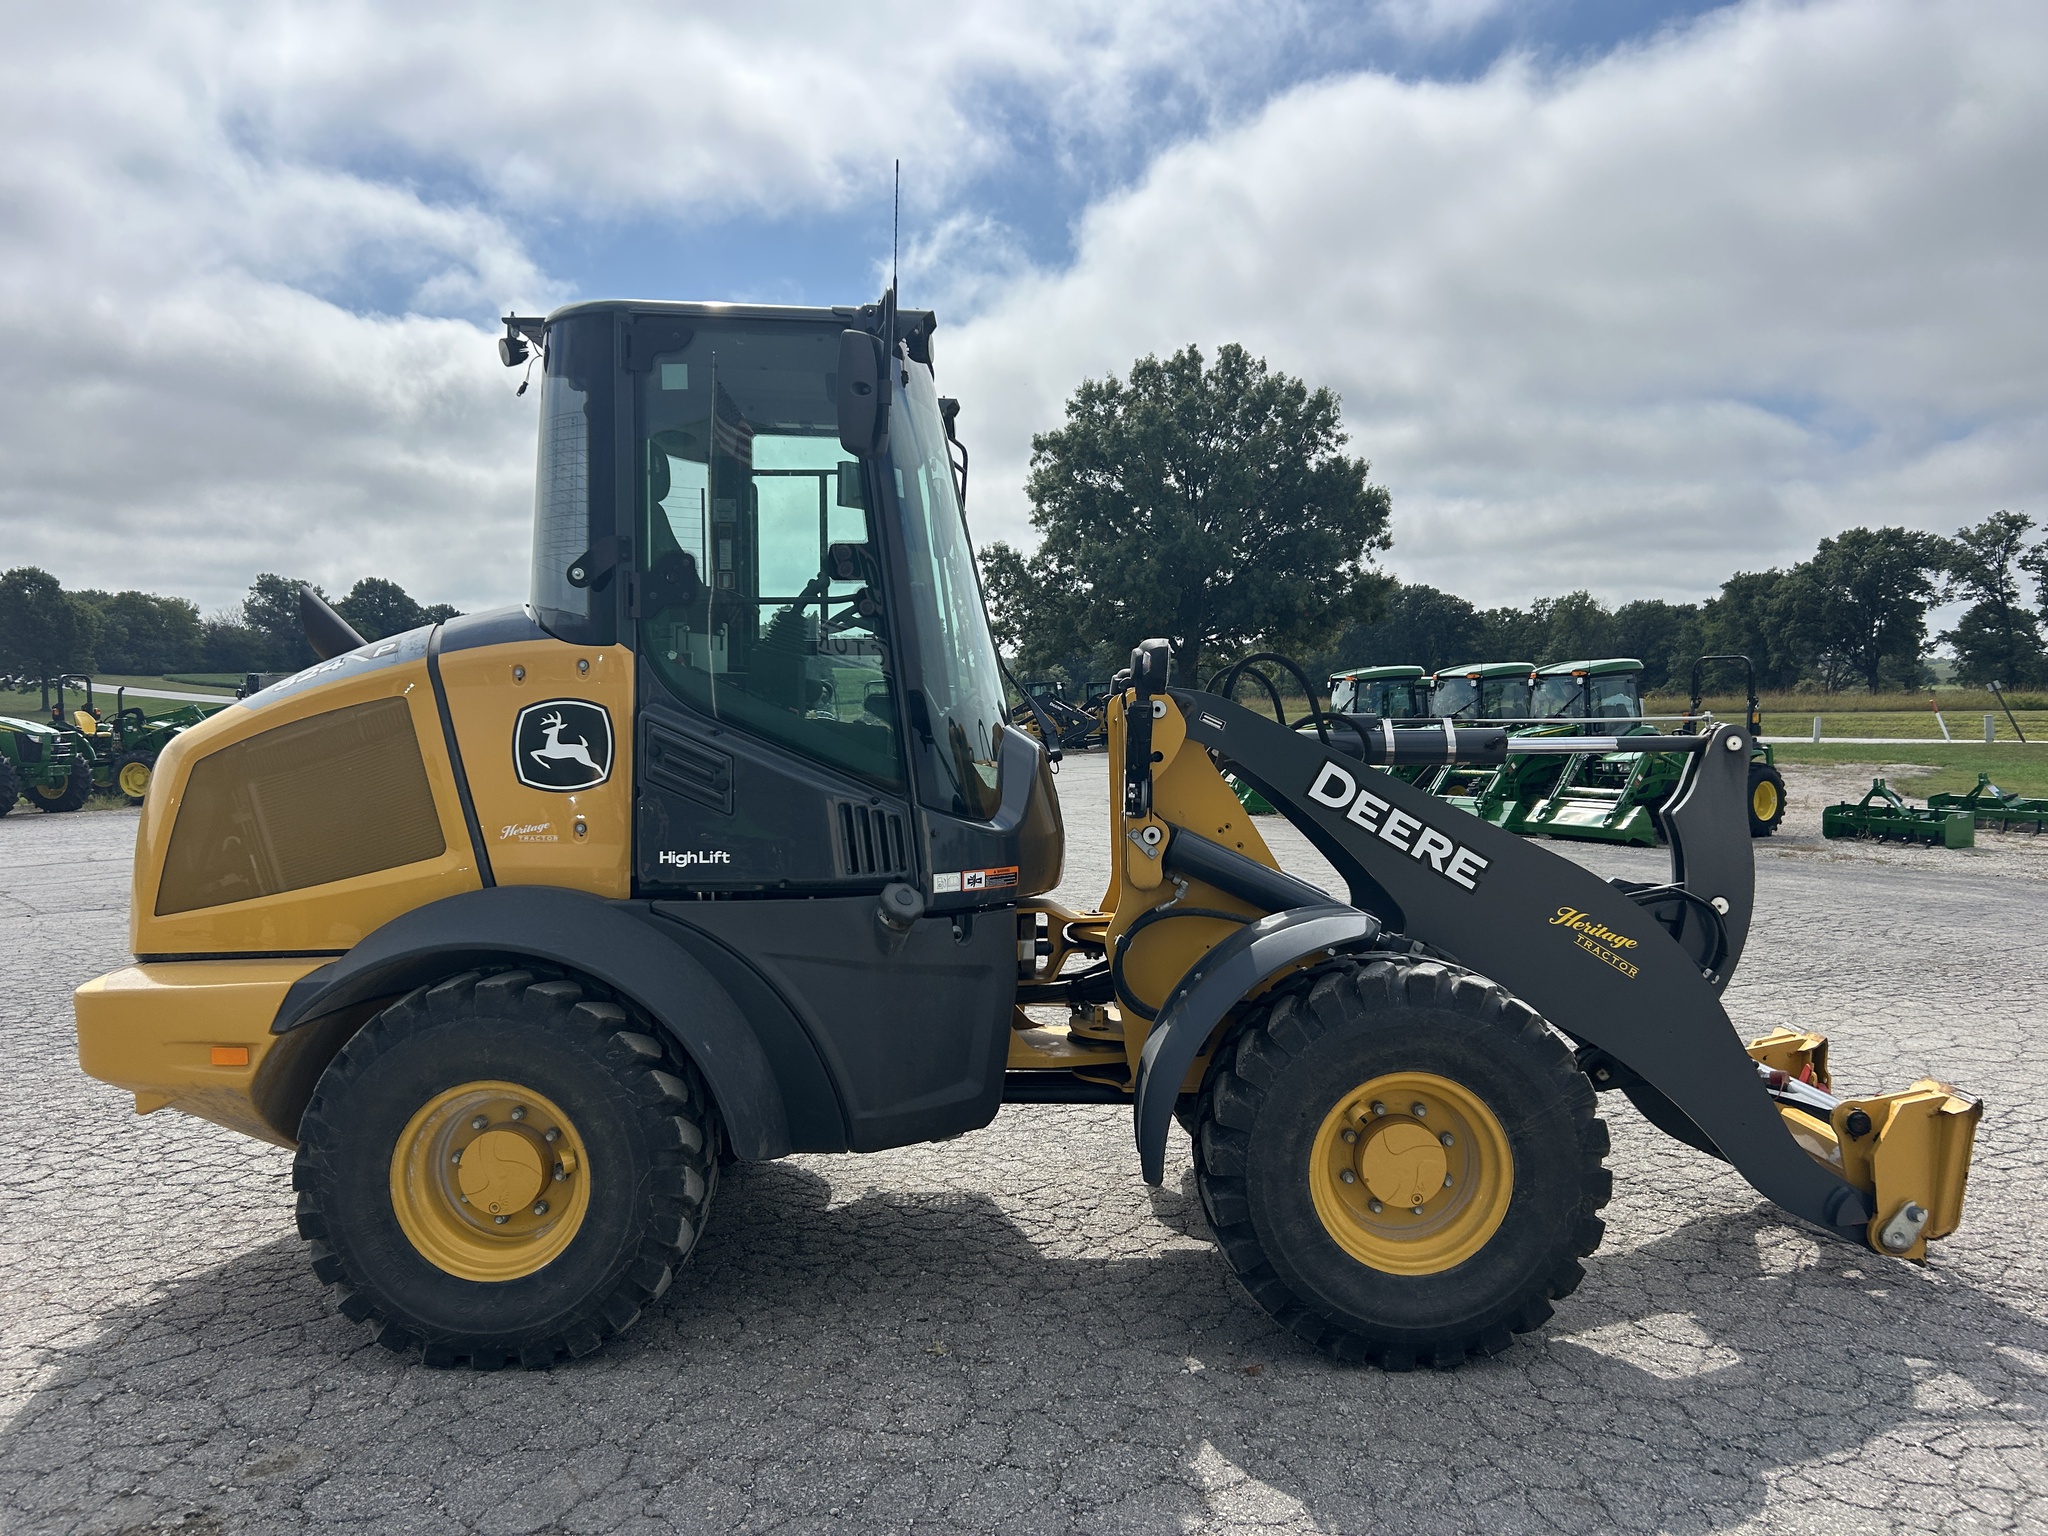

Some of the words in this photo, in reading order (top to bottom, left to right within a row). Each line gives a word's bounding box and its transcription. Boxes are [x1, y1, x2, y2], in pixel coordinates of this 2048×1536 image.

[500, 822, 551, 840] Heritage
[518, 834, 559, 842] TRACTOR
[1307, 760, 1489, 890] DEERE
[1548, 906, 1638, 949] Heritage
[1574, 933, 1640, 978] TRACTOR
